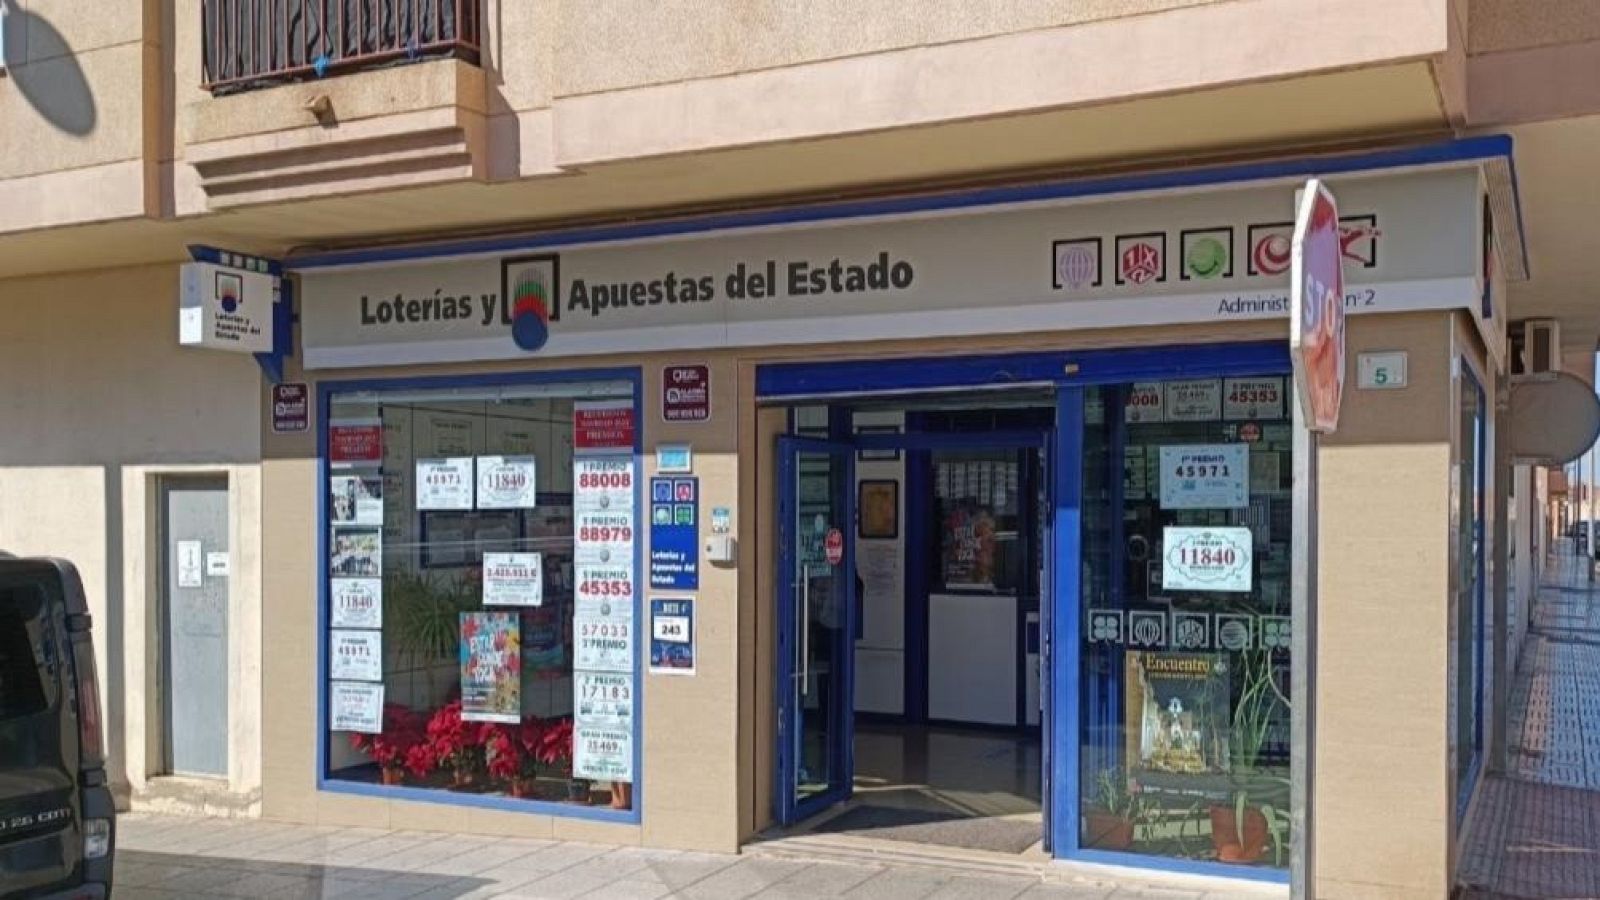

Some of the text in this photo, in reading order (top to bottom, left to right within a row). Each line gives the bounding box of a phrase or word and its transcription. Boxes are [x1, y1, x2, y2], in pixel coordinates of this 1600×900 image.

[360, 252, 914, 325] Loterías y Apuestas del Estado
[1218, 296, 1290, 314] Administ
[1364, 289, 1376, 306] 2
[1375, 367, 1388, 384] 5
[1229, 390, 1279, 403] 45353
[1175, 465, 1230, 477] 45971
[488, 473, 526, 489] 11840
[579, 472, 631, 488] 88008
[591, 516, 628, 526] PREMIO
[580, 527, 632, 541] 88979
[1179, 547, 1236, 566] 11840
[651, 562, 696, 573] Apuestas del
[591, 570, 628, 580] PREMIO
[651, 575, 676, 585] Estado
[579, 581, 632, 596] 45353
[339, 594, 373, 609] 11840
[581, 623, 628, 638] 57033
[661, 624, 682, 635] 243
[591, 639, 628, 650] PREMIO
[1146, 653, 1210, 673] Encuentro
[594, 676, 626, 686] PREMIO
[581, 685, 630, 699] 17183
